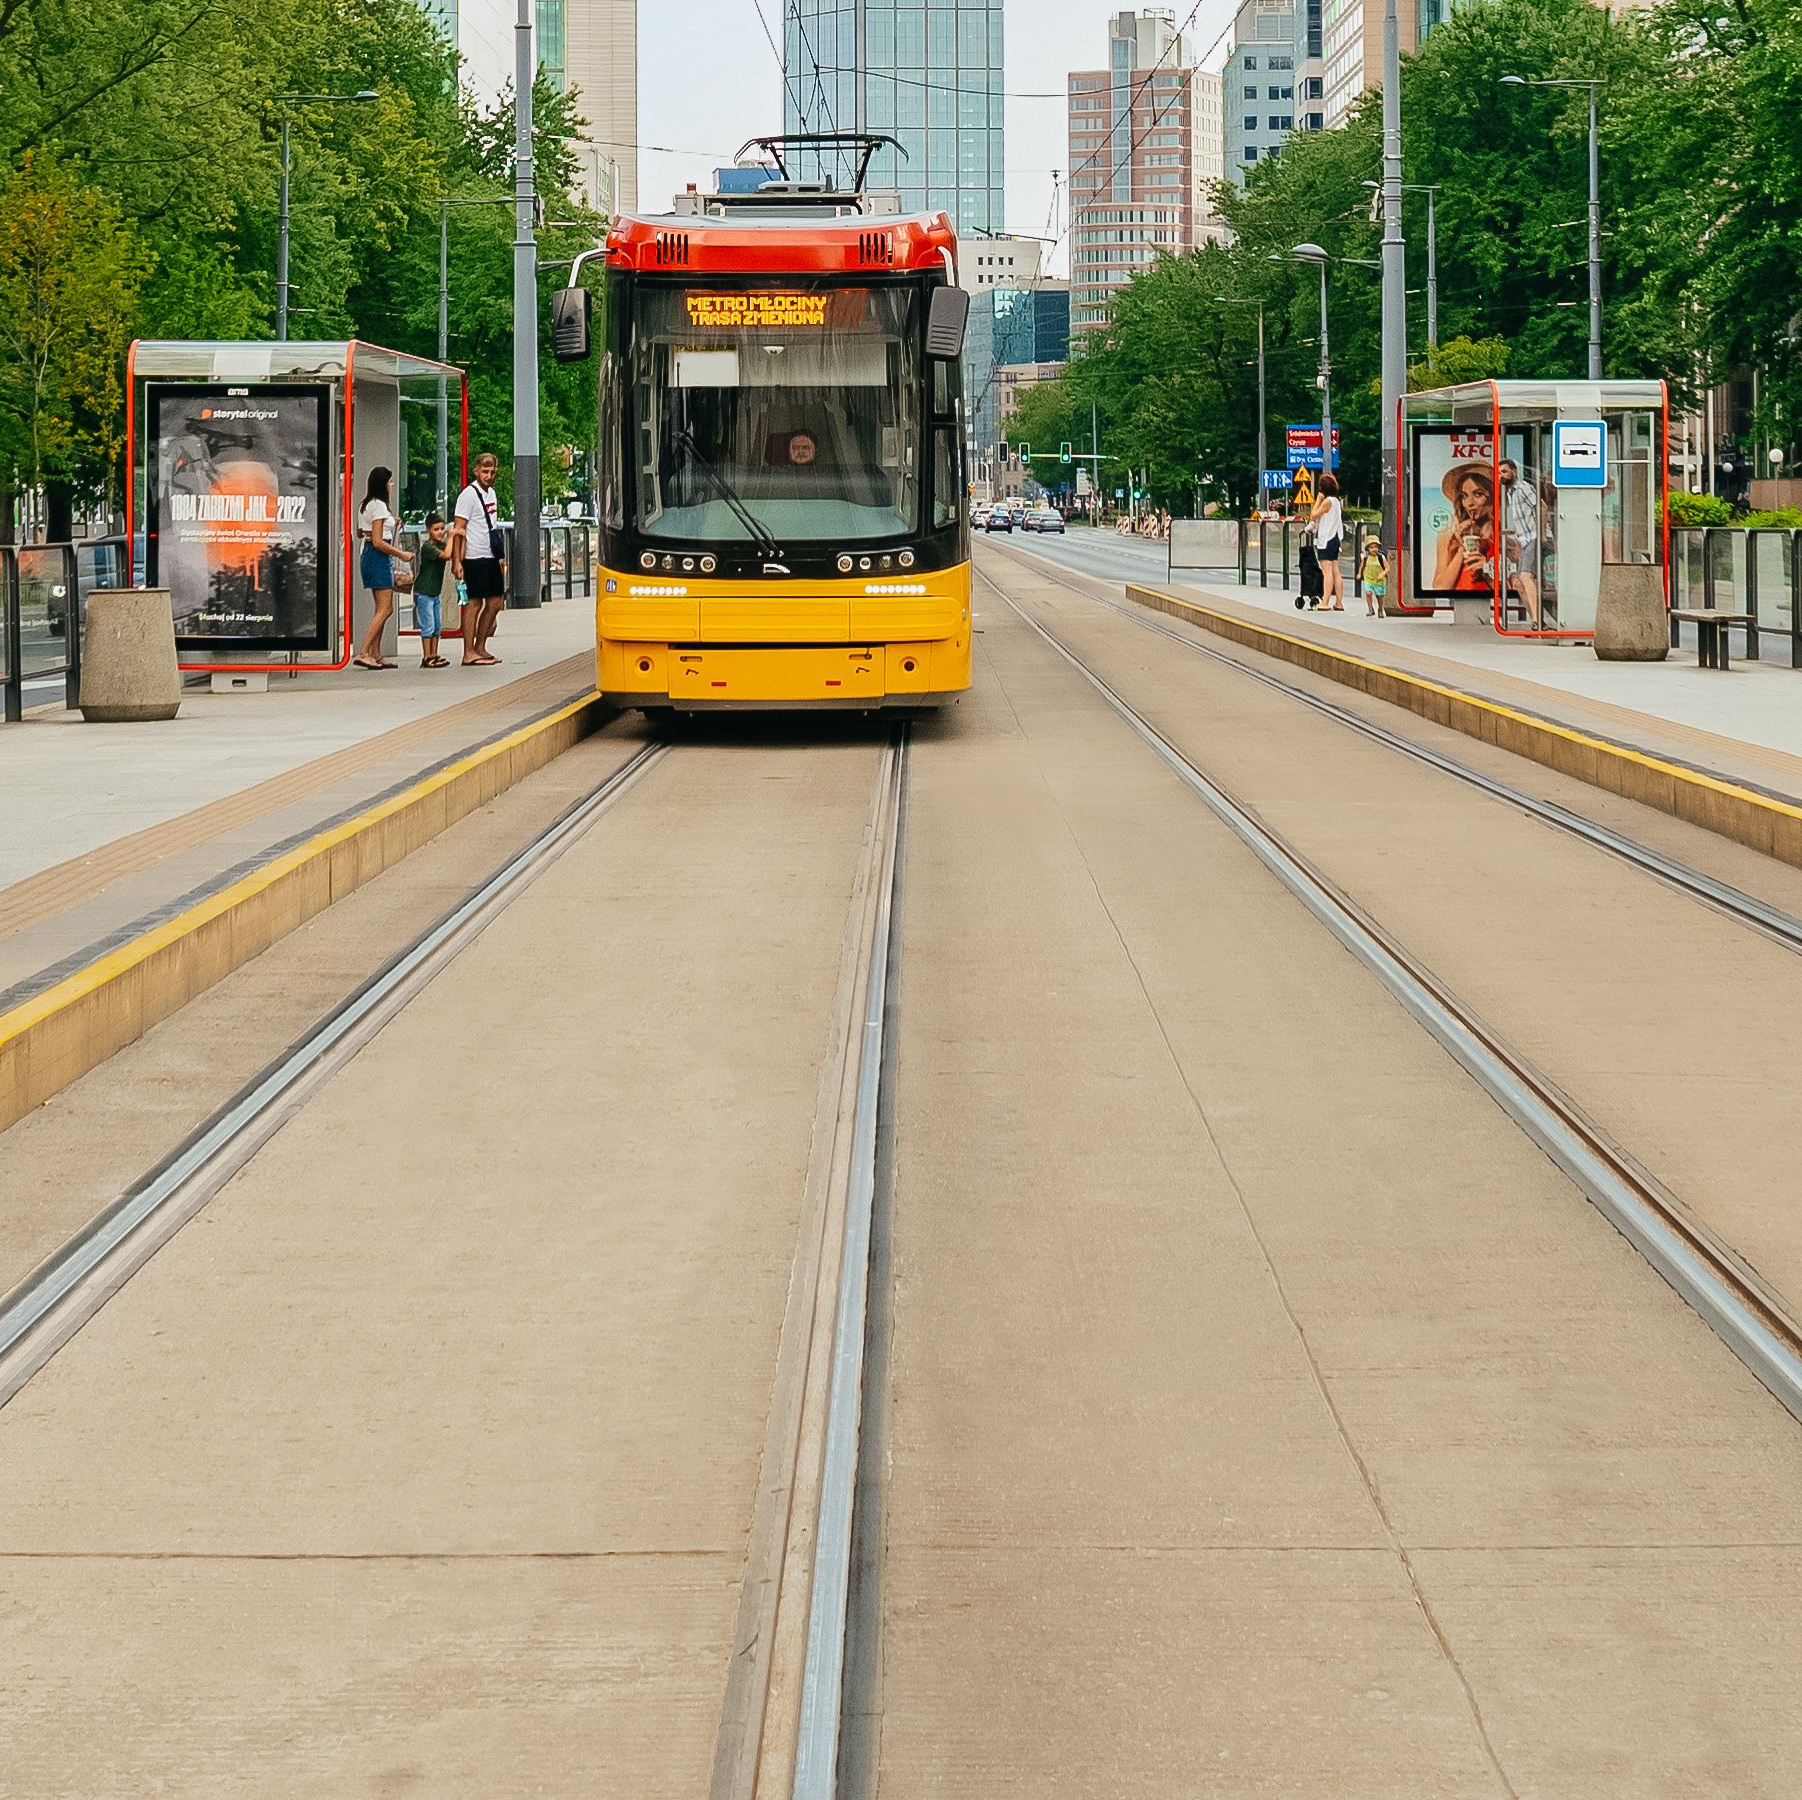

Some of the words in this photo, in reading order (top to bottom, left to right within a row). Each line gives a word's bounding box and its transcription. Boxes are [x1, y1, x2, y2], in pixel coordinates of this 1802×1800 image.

[687, 297, 747, 311] METRO
[749, 296, 827, 311] MŁOCINY
[690, 311, 741, 325] TRASA
[743, 311, 824, 325] ZMIENIONA
[212, 409, 248, 421] storytel
[1452, 444, 1492, 458] KFC
[277, 496, 306, 522] 2022
